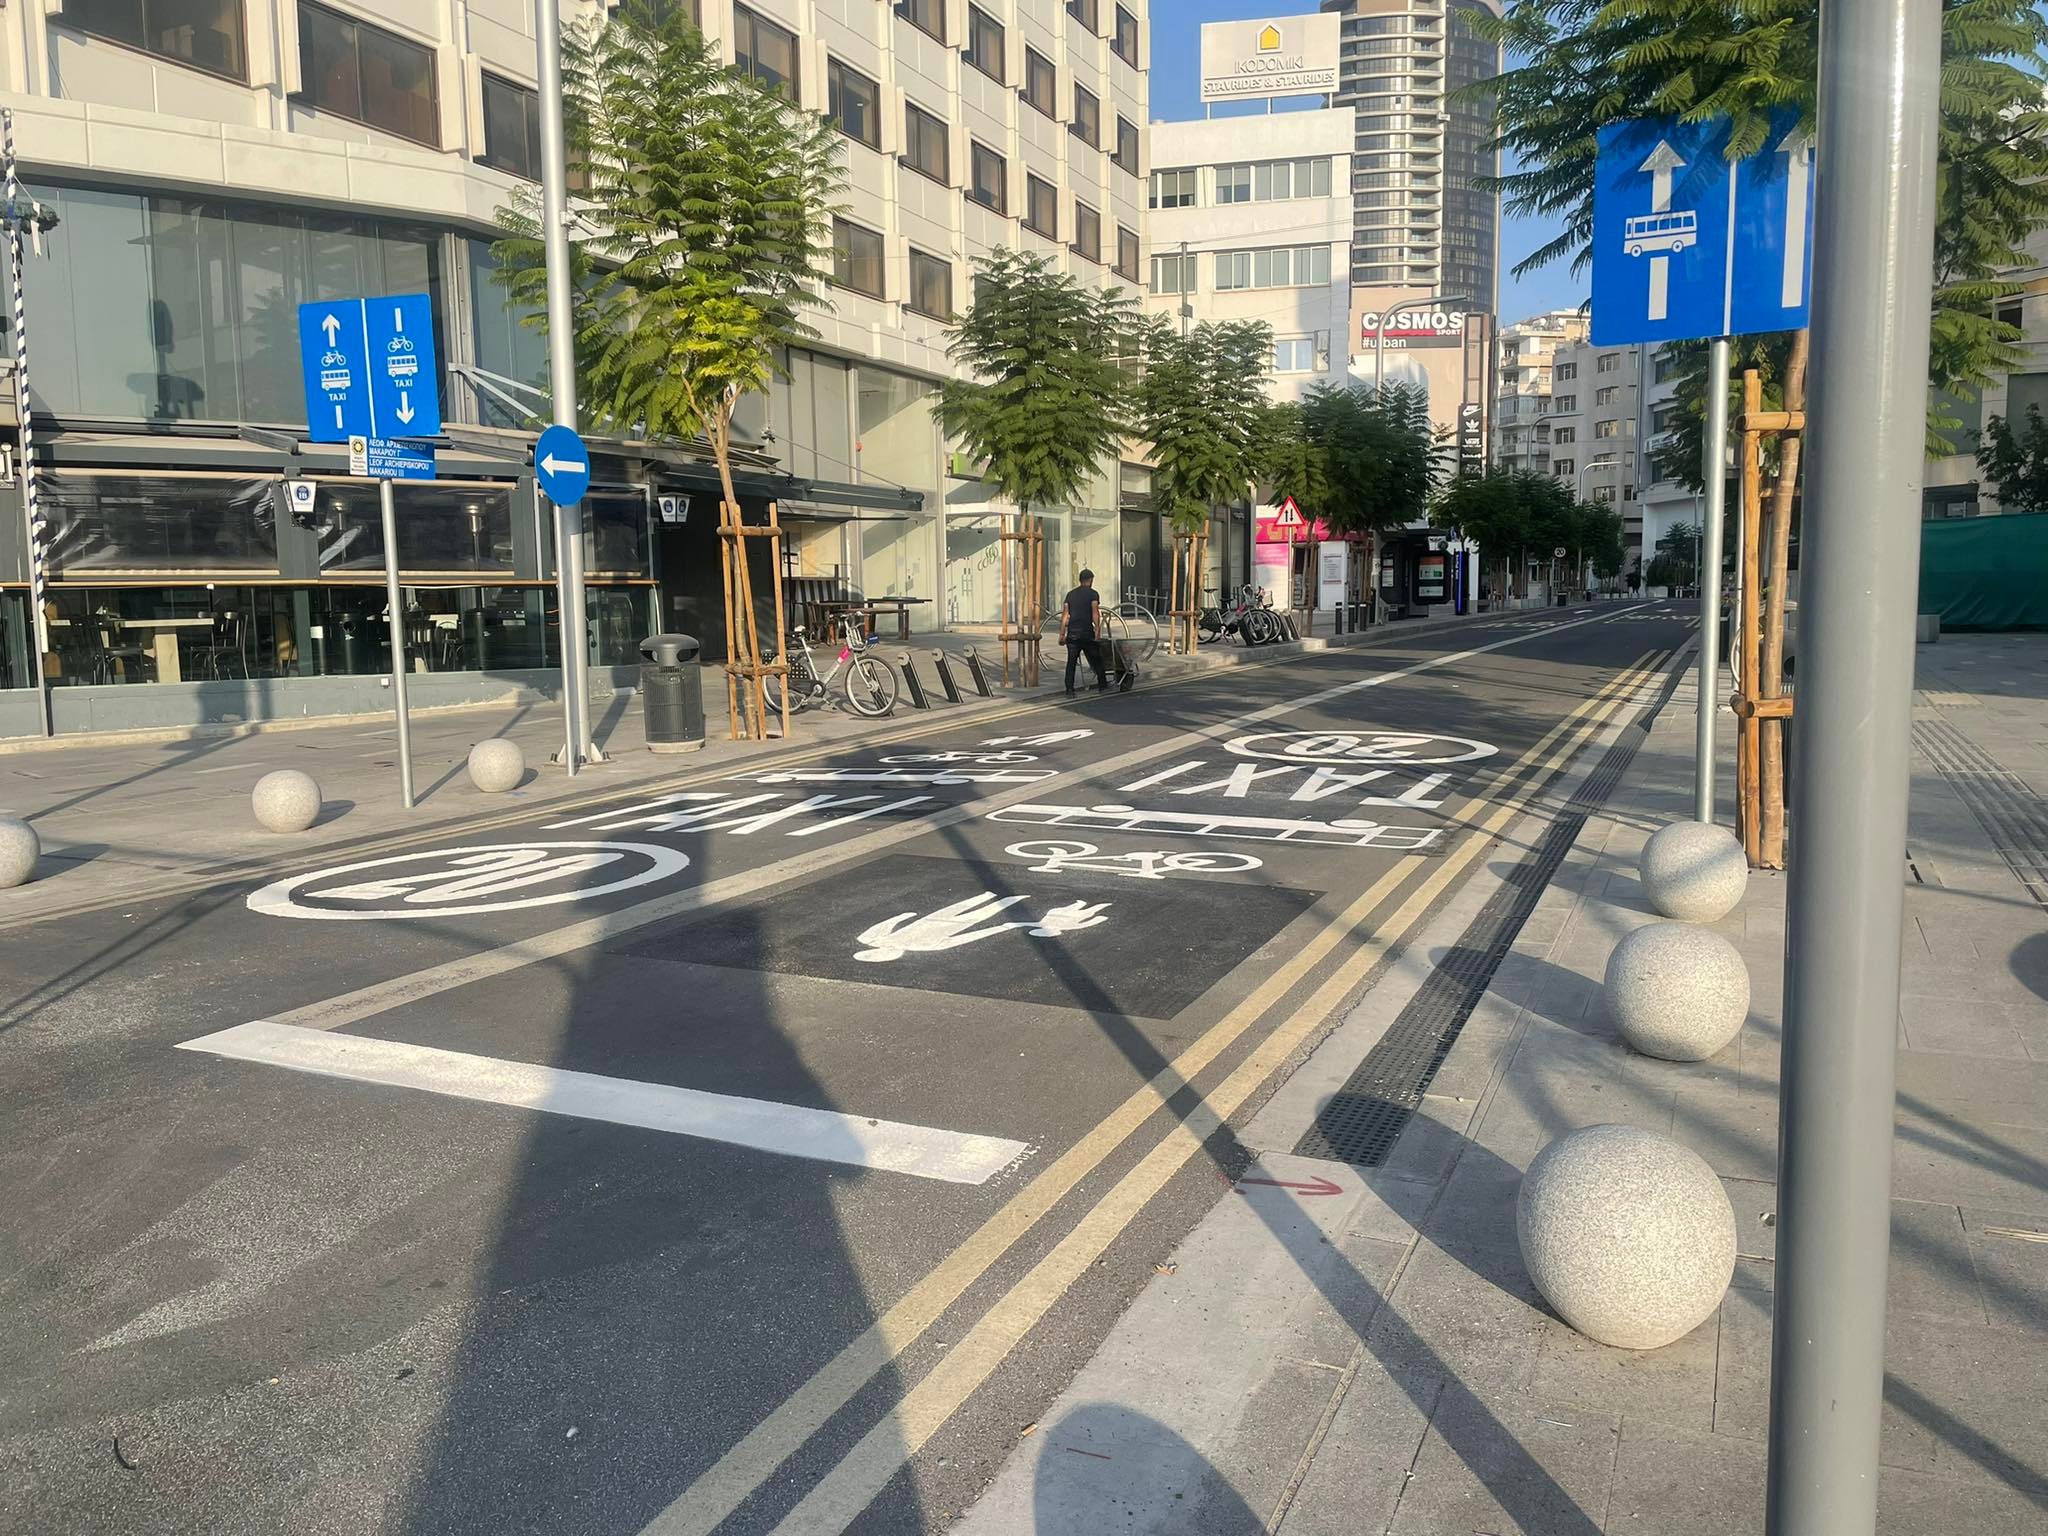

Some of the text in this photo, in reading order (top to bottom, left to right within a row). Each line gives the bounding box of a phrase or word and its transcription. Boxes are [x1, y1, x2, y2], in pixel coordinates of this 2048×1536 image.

[1204, 71, 1335, 93] STAVRIDES & STAVRIDES
[1362, 311, 1463, 330] COSMOS
[1362, 337, 1407, 348] #uban
[394, 379, 413, 388] TAXI
[328, 393, 347, 401] TAXI
[369, 467, 397, 476] MAKARIOU
[1116, 761, 1453, 809] TAXI
[538, 792, 934, 836] TAXI
[304, 849, 625, 902] 20
